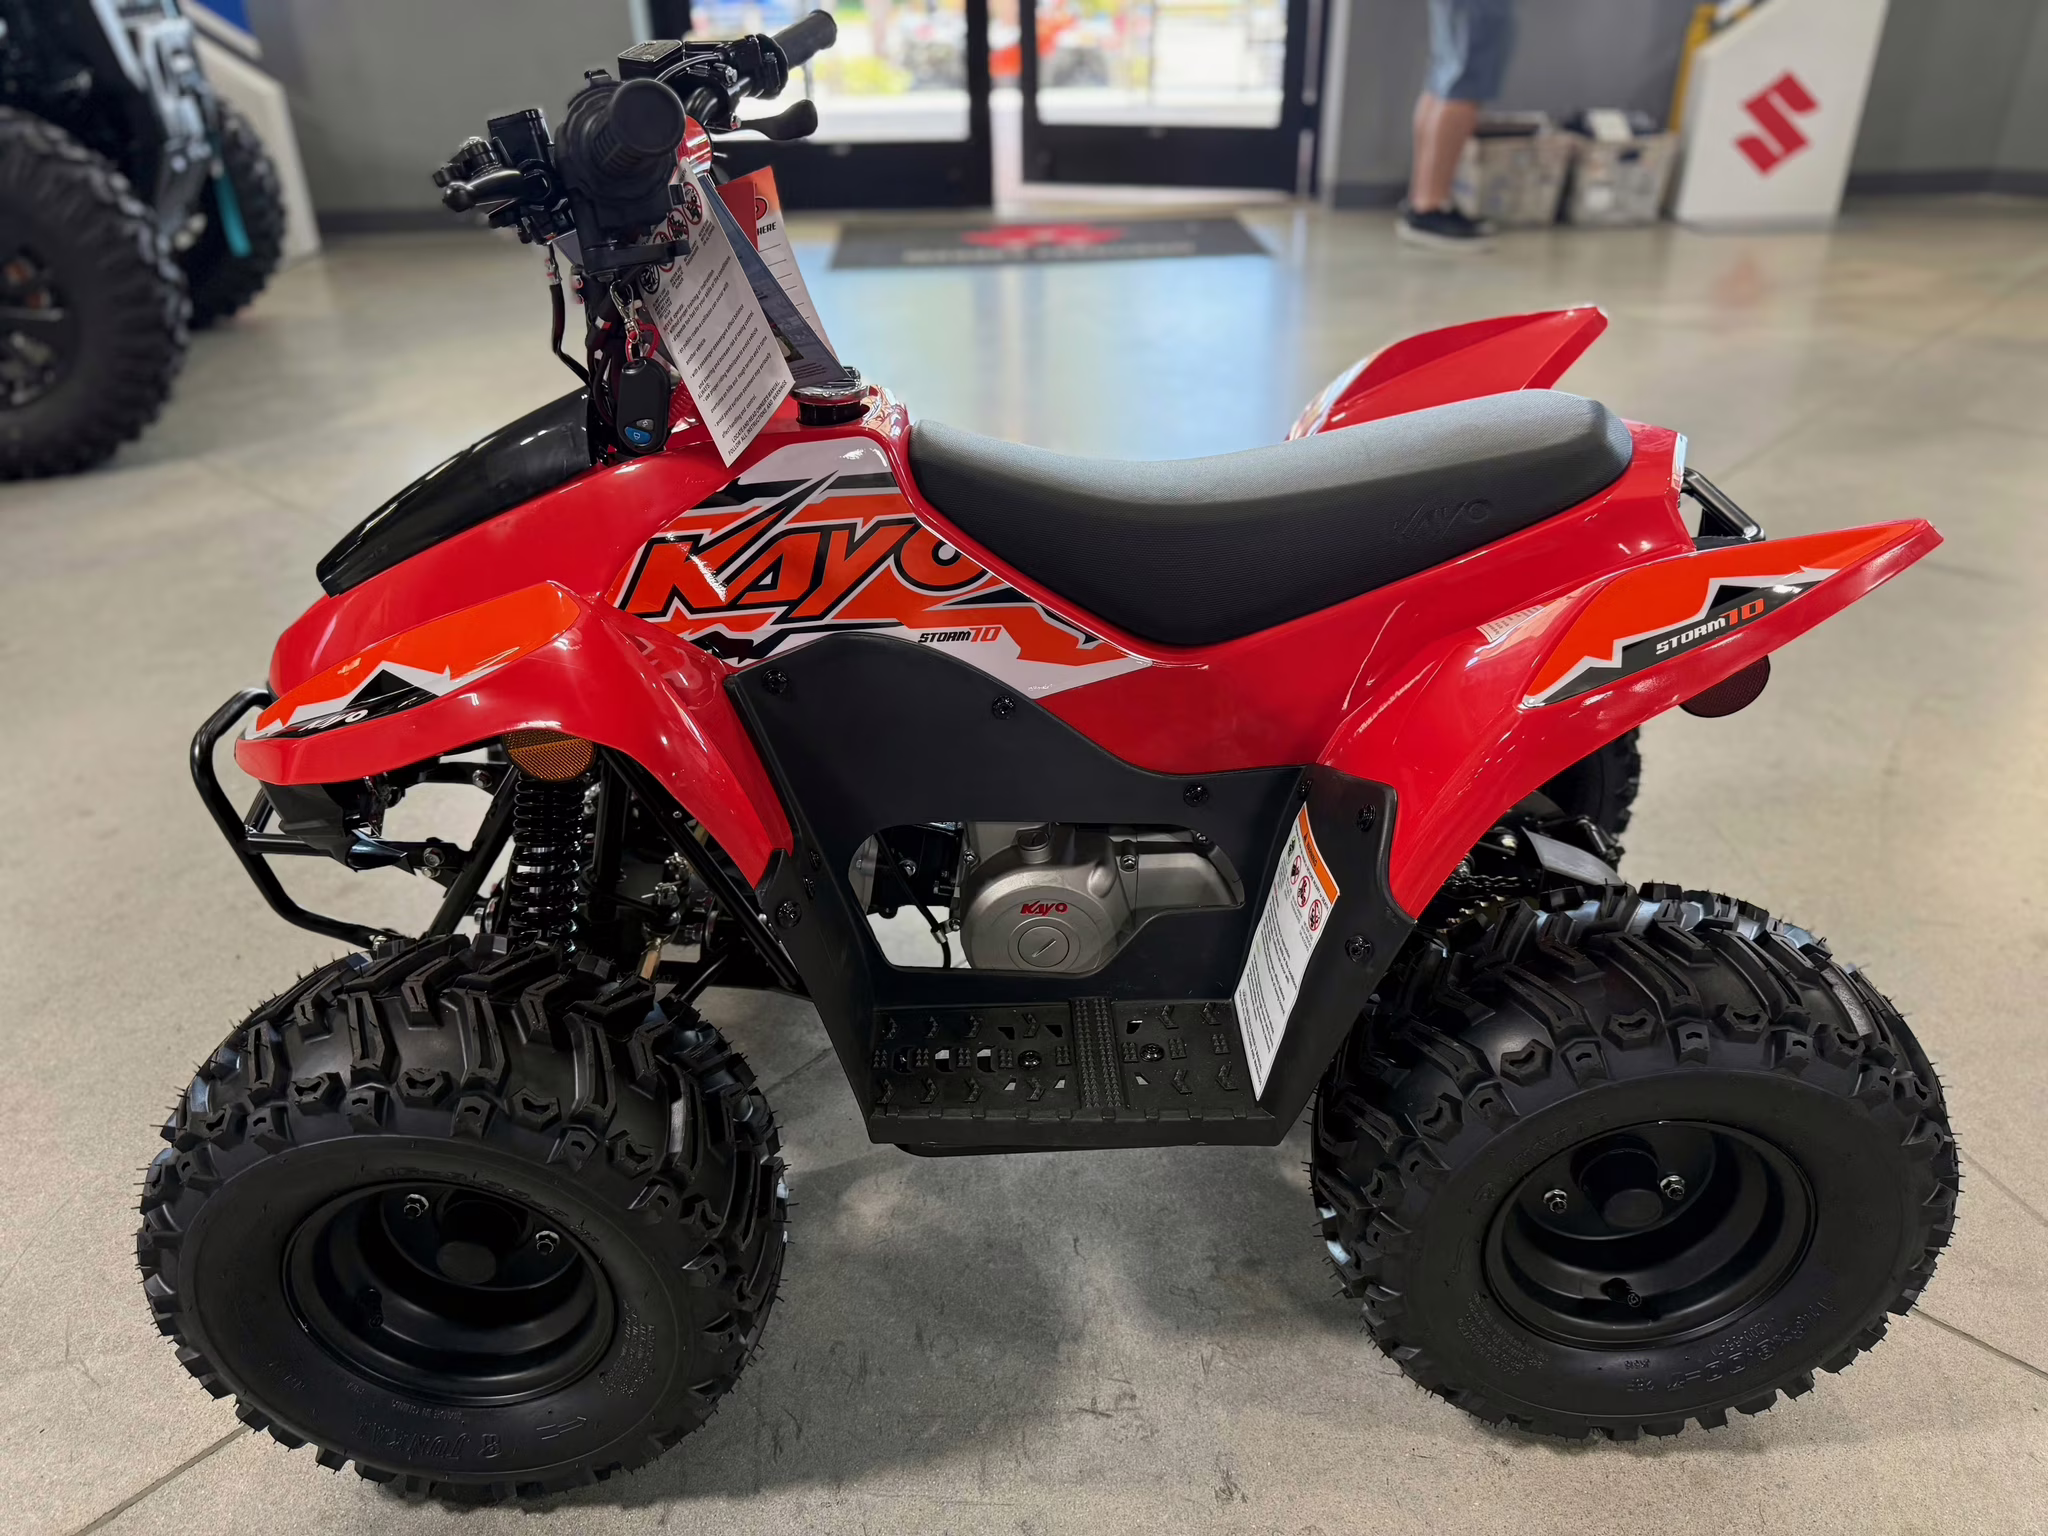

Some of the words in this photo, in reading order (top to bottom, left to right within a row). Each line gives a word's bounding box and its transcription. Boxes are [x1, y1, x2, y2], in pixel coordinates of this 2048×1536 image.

[727, 437, 741, 457] FOLLOW
[739, 431, 747, 442] ALL
[745, 405, 767, 435] INSTRUCTIONS
[765, 397, 773, 410] AND
[731, 426, 743, 444] LOCATE
[741, 418, 749, 430] AND
[747, 409, 757, 423] READ
[617, 506, 990, 624] KAYO
[1020, 900, 1068, 917] KAYO
